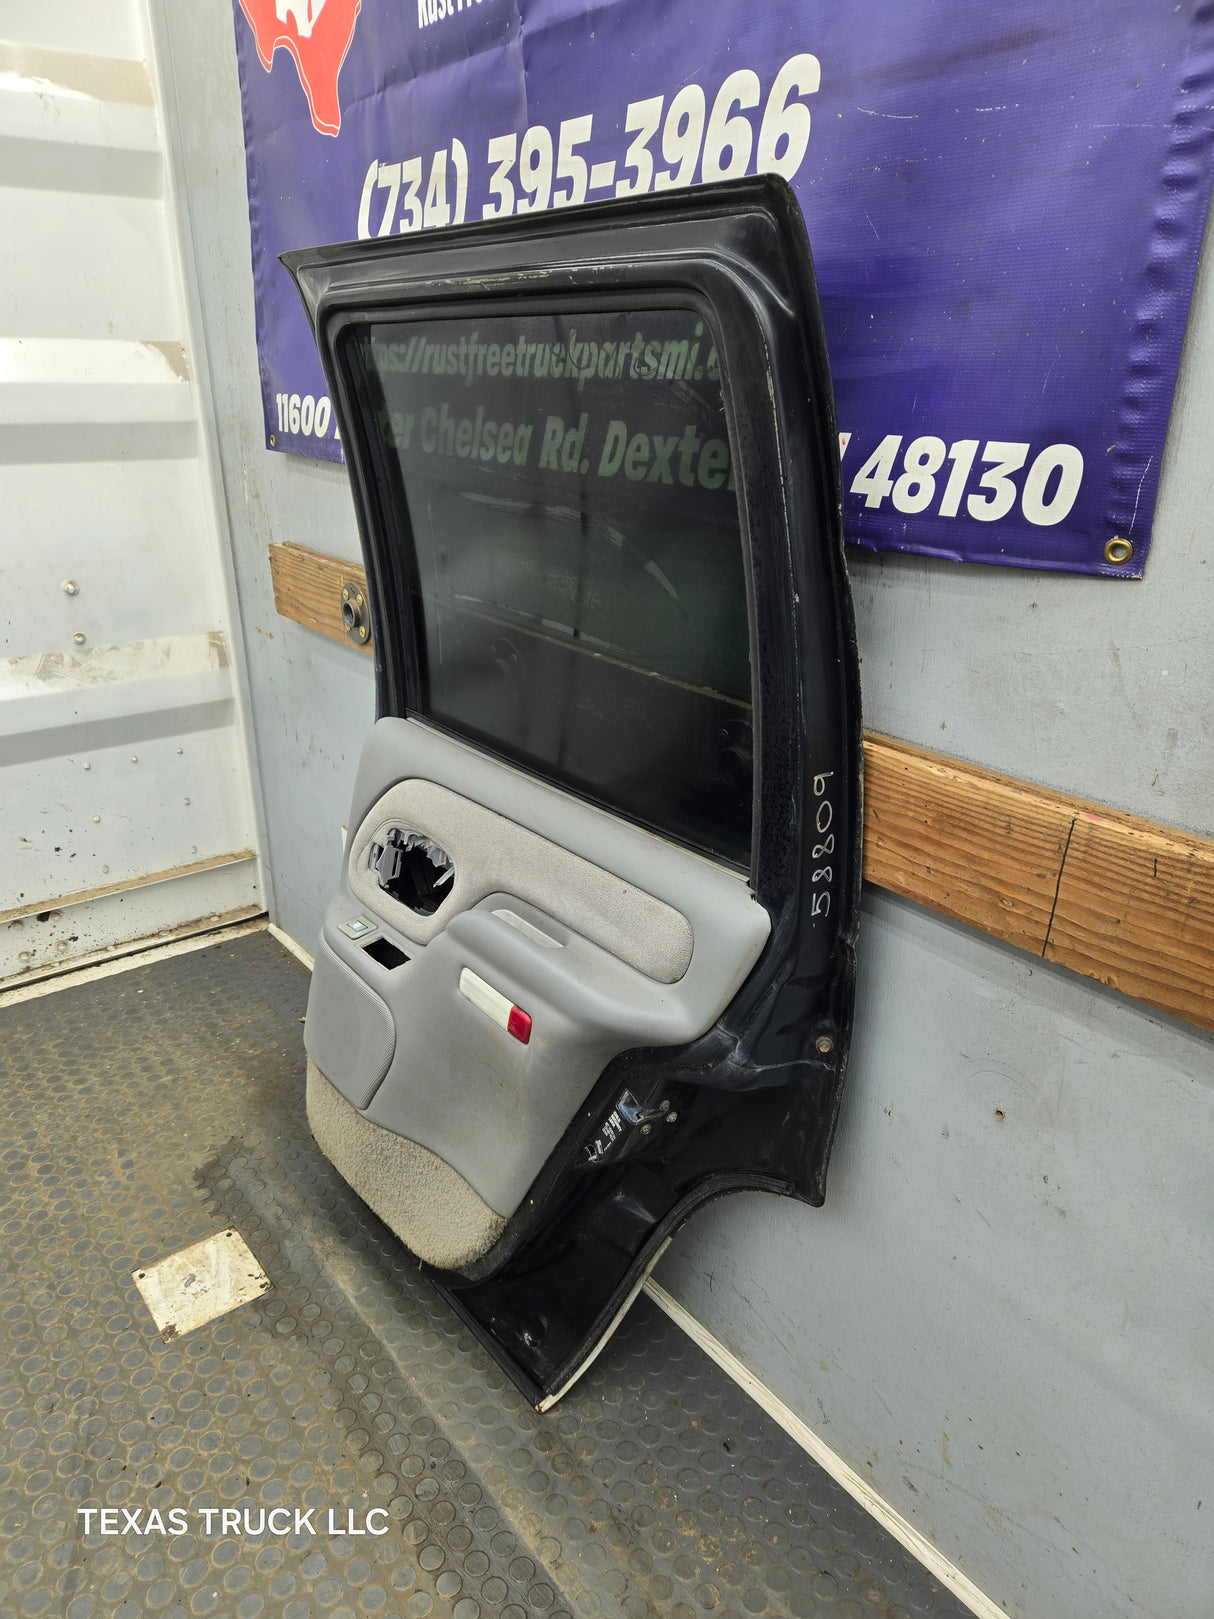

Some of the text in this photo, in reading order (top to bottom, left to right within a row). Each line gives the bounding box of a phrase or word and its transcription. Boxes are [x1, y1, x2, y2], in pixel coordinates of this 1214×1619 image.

[358, 53, 821, 240] (734) 395-3966
[276, 393, 331, 438] 11600
[420, 403, 533, 466] Chelsea
[539, 411, 590, 475] Rd.
[598, 420, 737, 491] Dexte
[850, 434, 1084, 526] 48130
[811, 771, 835, 917] 58809
